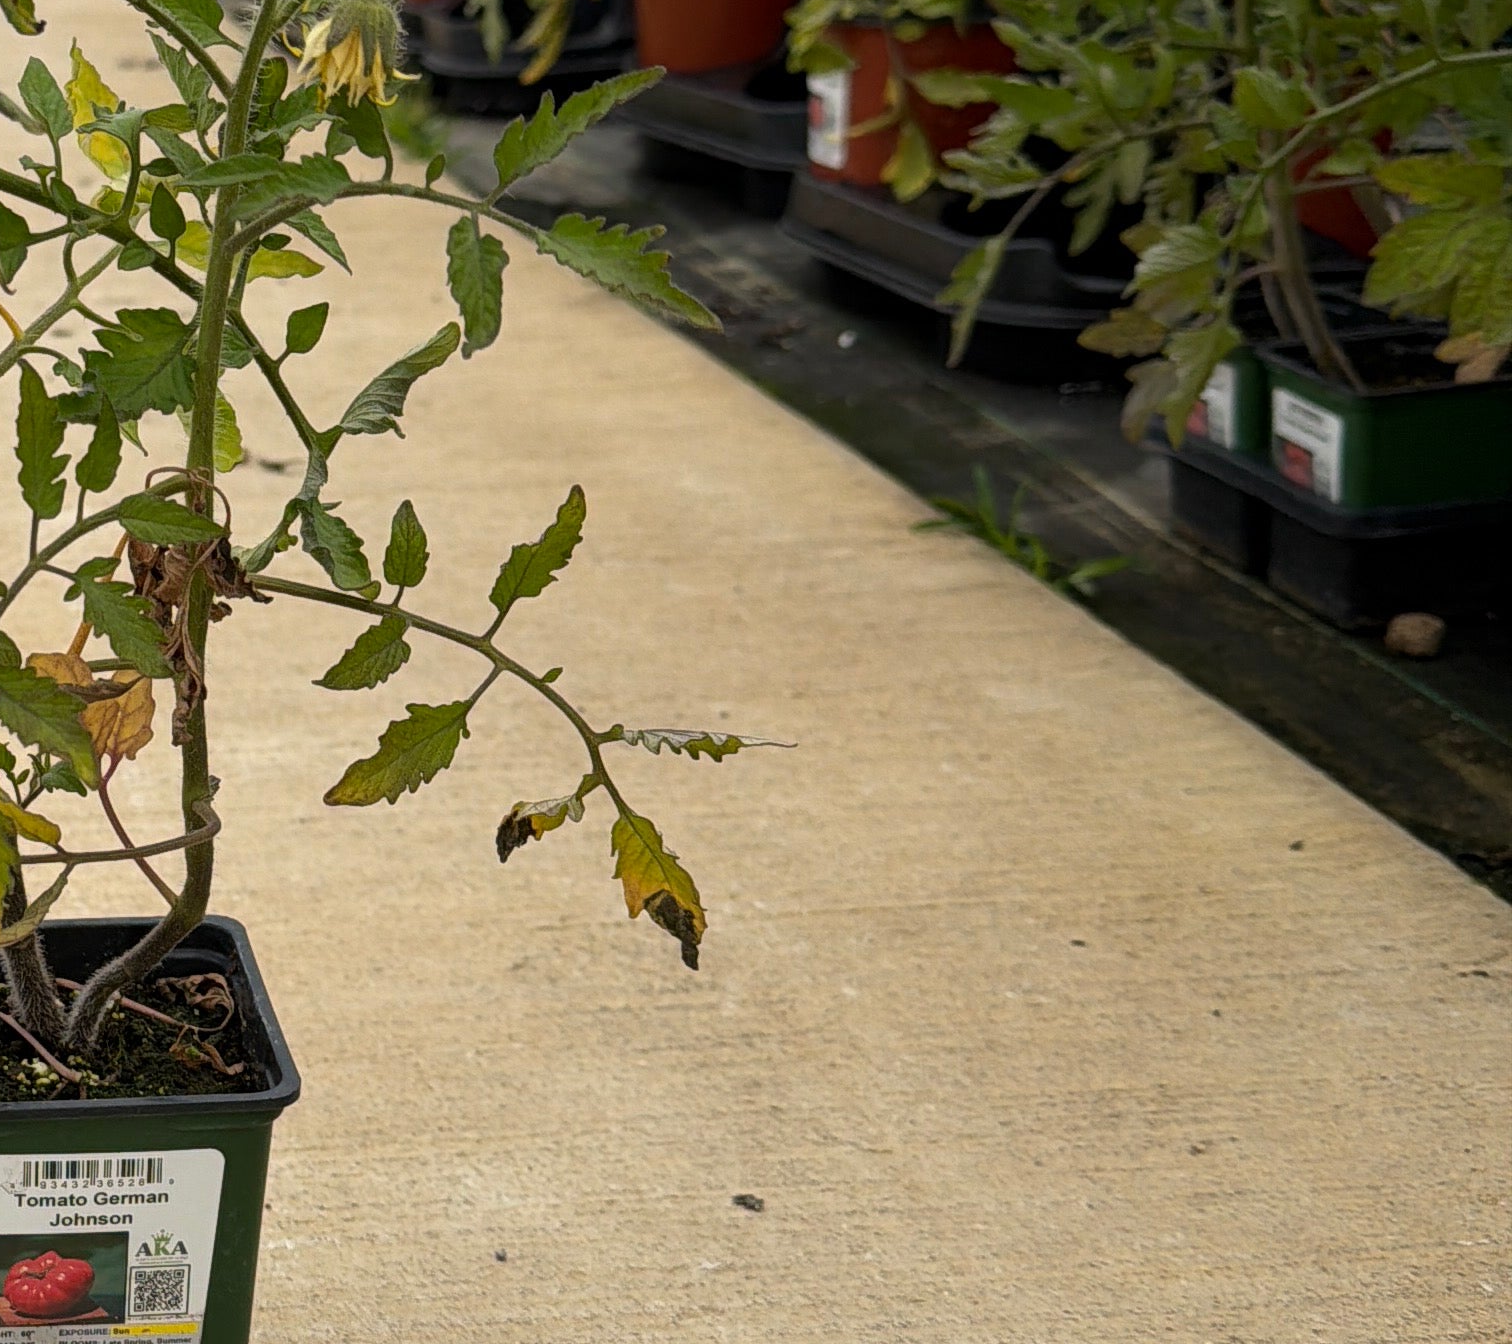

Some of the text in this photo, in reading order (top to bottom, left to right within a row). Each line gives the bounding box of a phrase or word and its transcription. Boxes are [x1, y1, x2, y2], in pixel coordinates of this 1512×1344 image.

[14, 1191, 169, 1207] Tomato German
[49, 1213, 133, 1227] Johnson
[135, 1240, 188, 1257] AKA
[58, 1328, 110, 1336] EXPOSURE:
[157, 1337, 192, 1344] Summer
